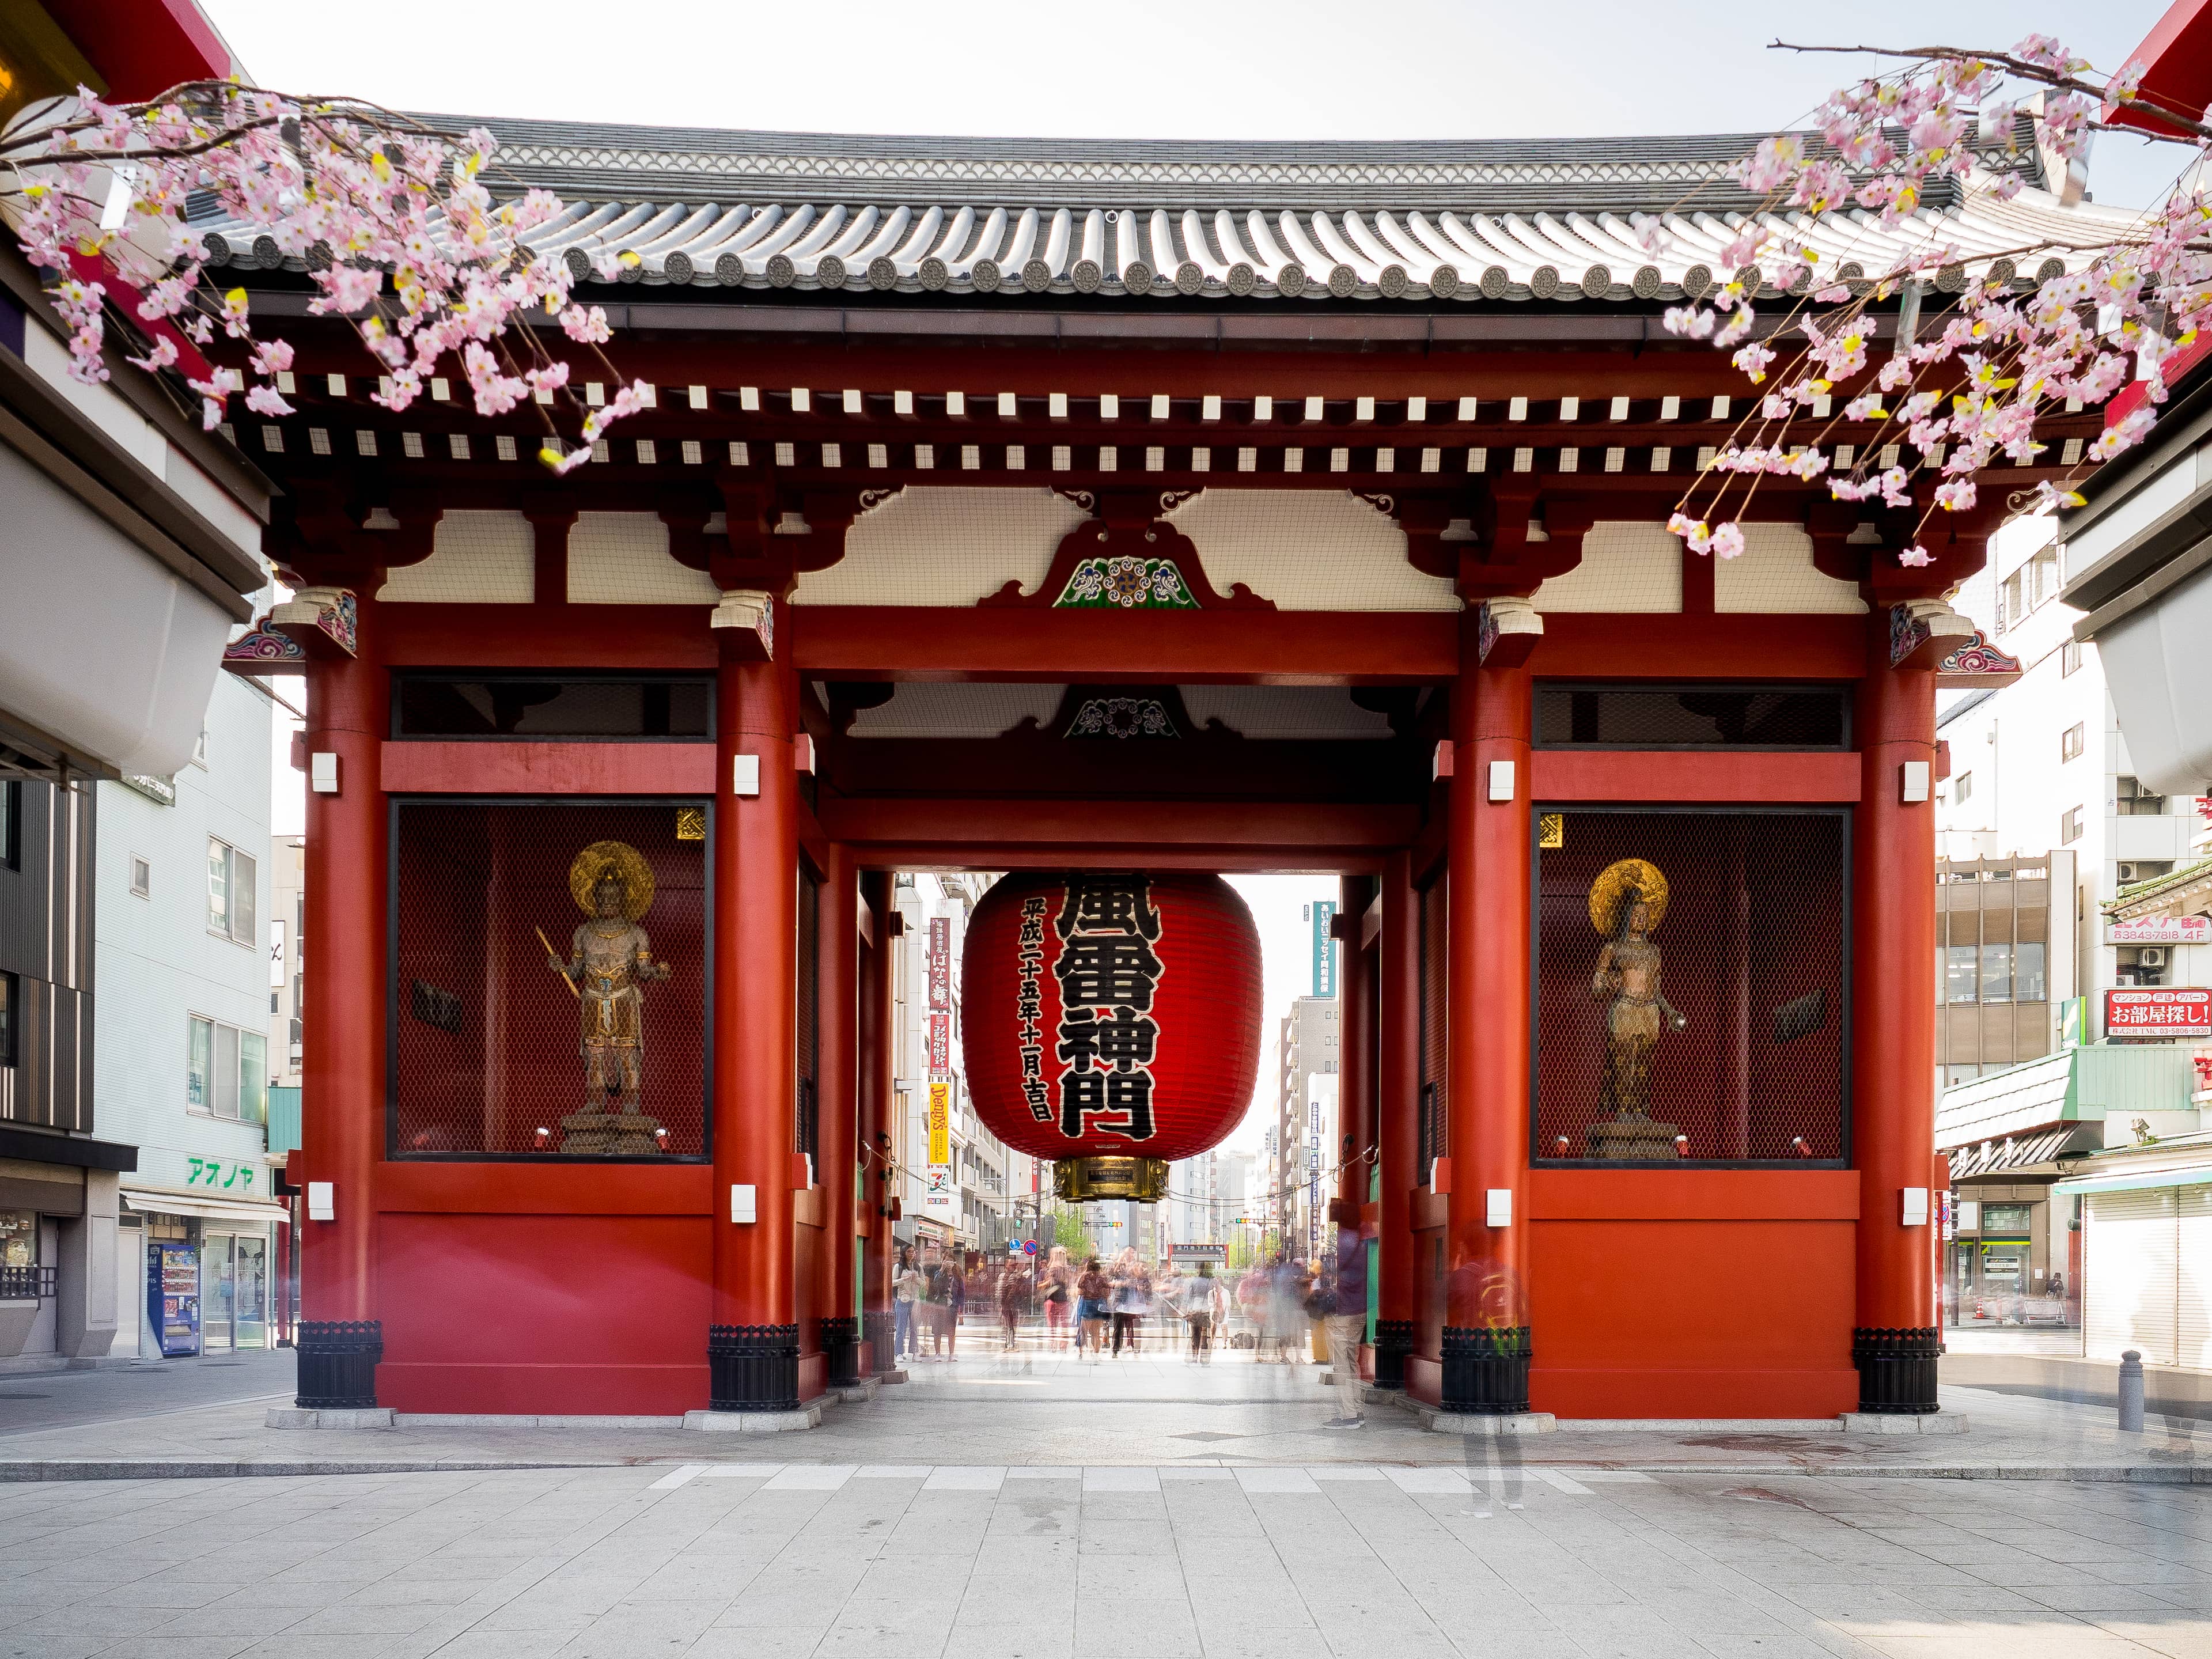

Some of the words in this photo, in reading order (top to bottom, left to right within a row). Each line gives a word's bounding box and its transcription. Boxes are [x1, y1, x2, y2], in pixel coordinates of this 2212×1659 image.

[1017, 897, 1054, 1122] 平成二十五年十一月吉日
[1053, 873, 1165, 1141] 風雷神門
[2112, 1005, 2209, 1024] お部屋探し!
[930, 1086, 948, 1130] Denny's
[188, 1158, 253, 1191] アオノヤ
